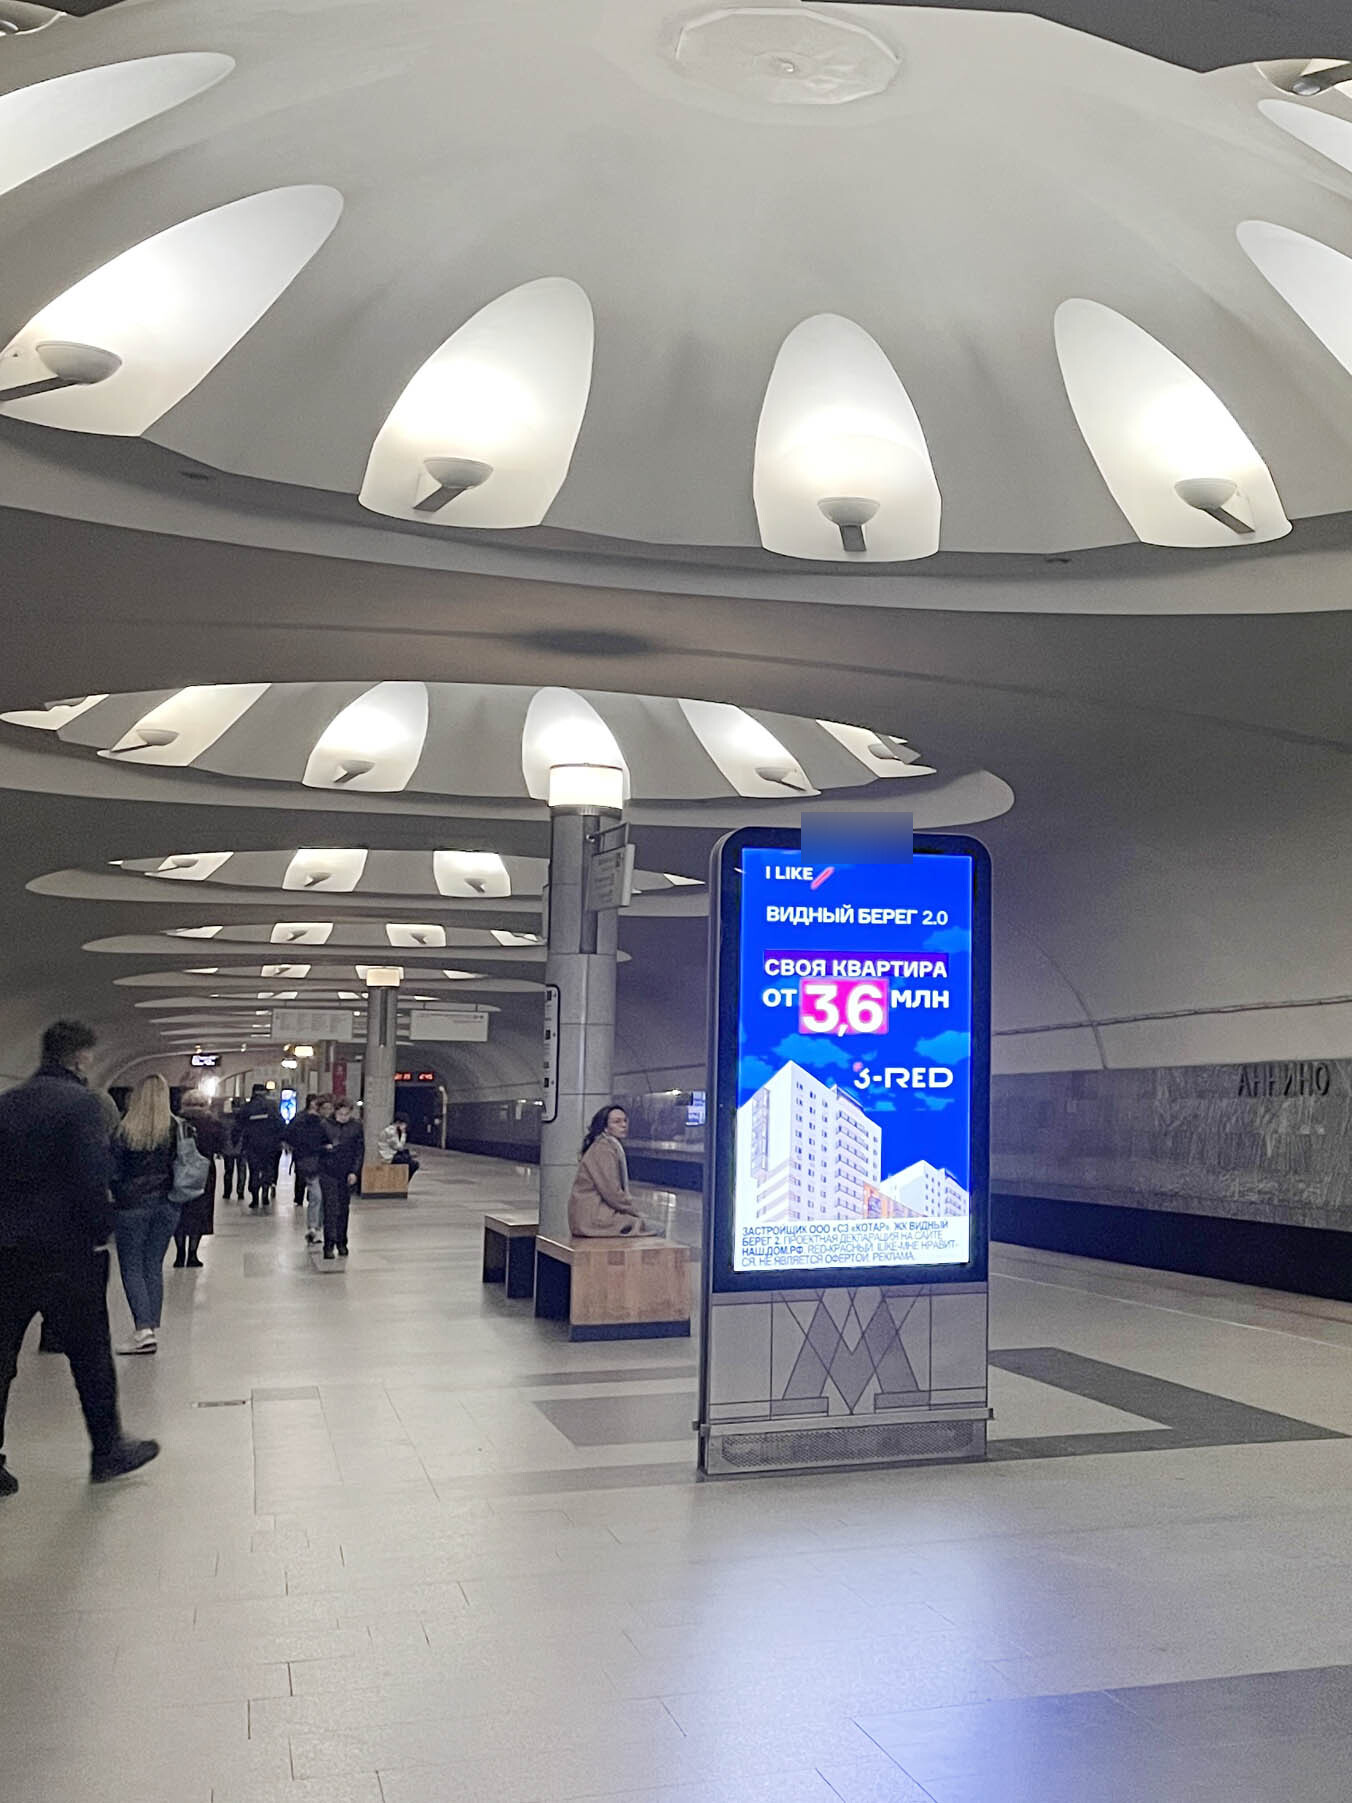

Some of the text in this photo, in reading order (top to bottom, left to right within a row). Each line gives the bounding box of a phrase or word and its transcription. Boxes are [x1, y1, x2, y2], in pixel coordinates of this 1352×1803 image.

[765, 866, 814, 881] I LIKE
[766, 904, 949, 926] ВИДНЫЙ БЕРЕГ 2.0
[764, 958, 948, 978] СВОЯ КВАРТИРА
[762, 984, 950, 1037] ОТ 3,6 МЛН
[1237, 1062, 1331, 1097] АННИНО
[809, 1224, 831, 1234] ООО
